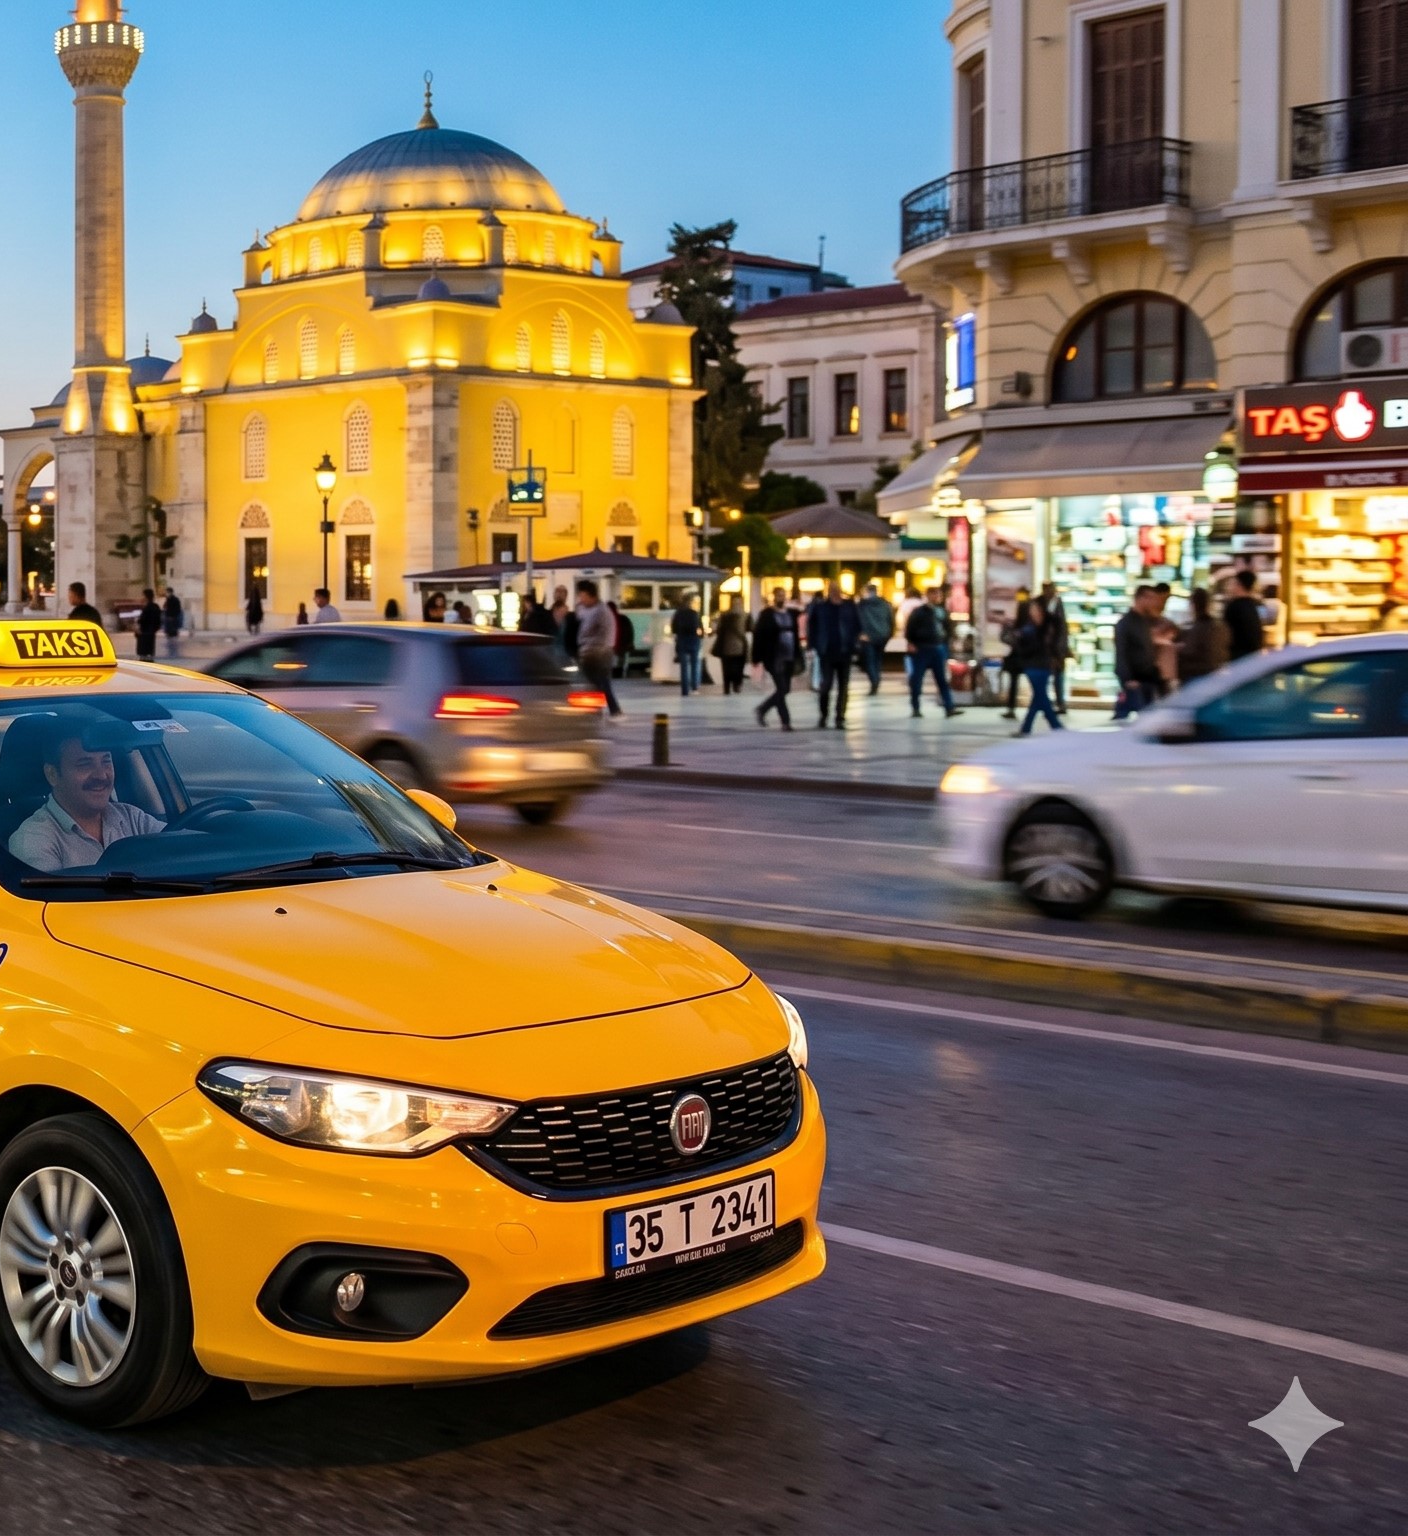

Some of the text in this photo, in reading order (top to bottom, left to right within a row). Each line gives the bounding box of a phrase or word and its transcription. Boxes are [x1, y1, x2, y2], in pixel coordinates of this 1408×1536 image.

[1248, 404, 1330, 442] TAŞ
[16, 631, 99, 657] TAKSI
[629, 1210, 664, 1258] 35
[680, 1202, 695, 1245] T
[711, 1182, 767, 1238] 2341
